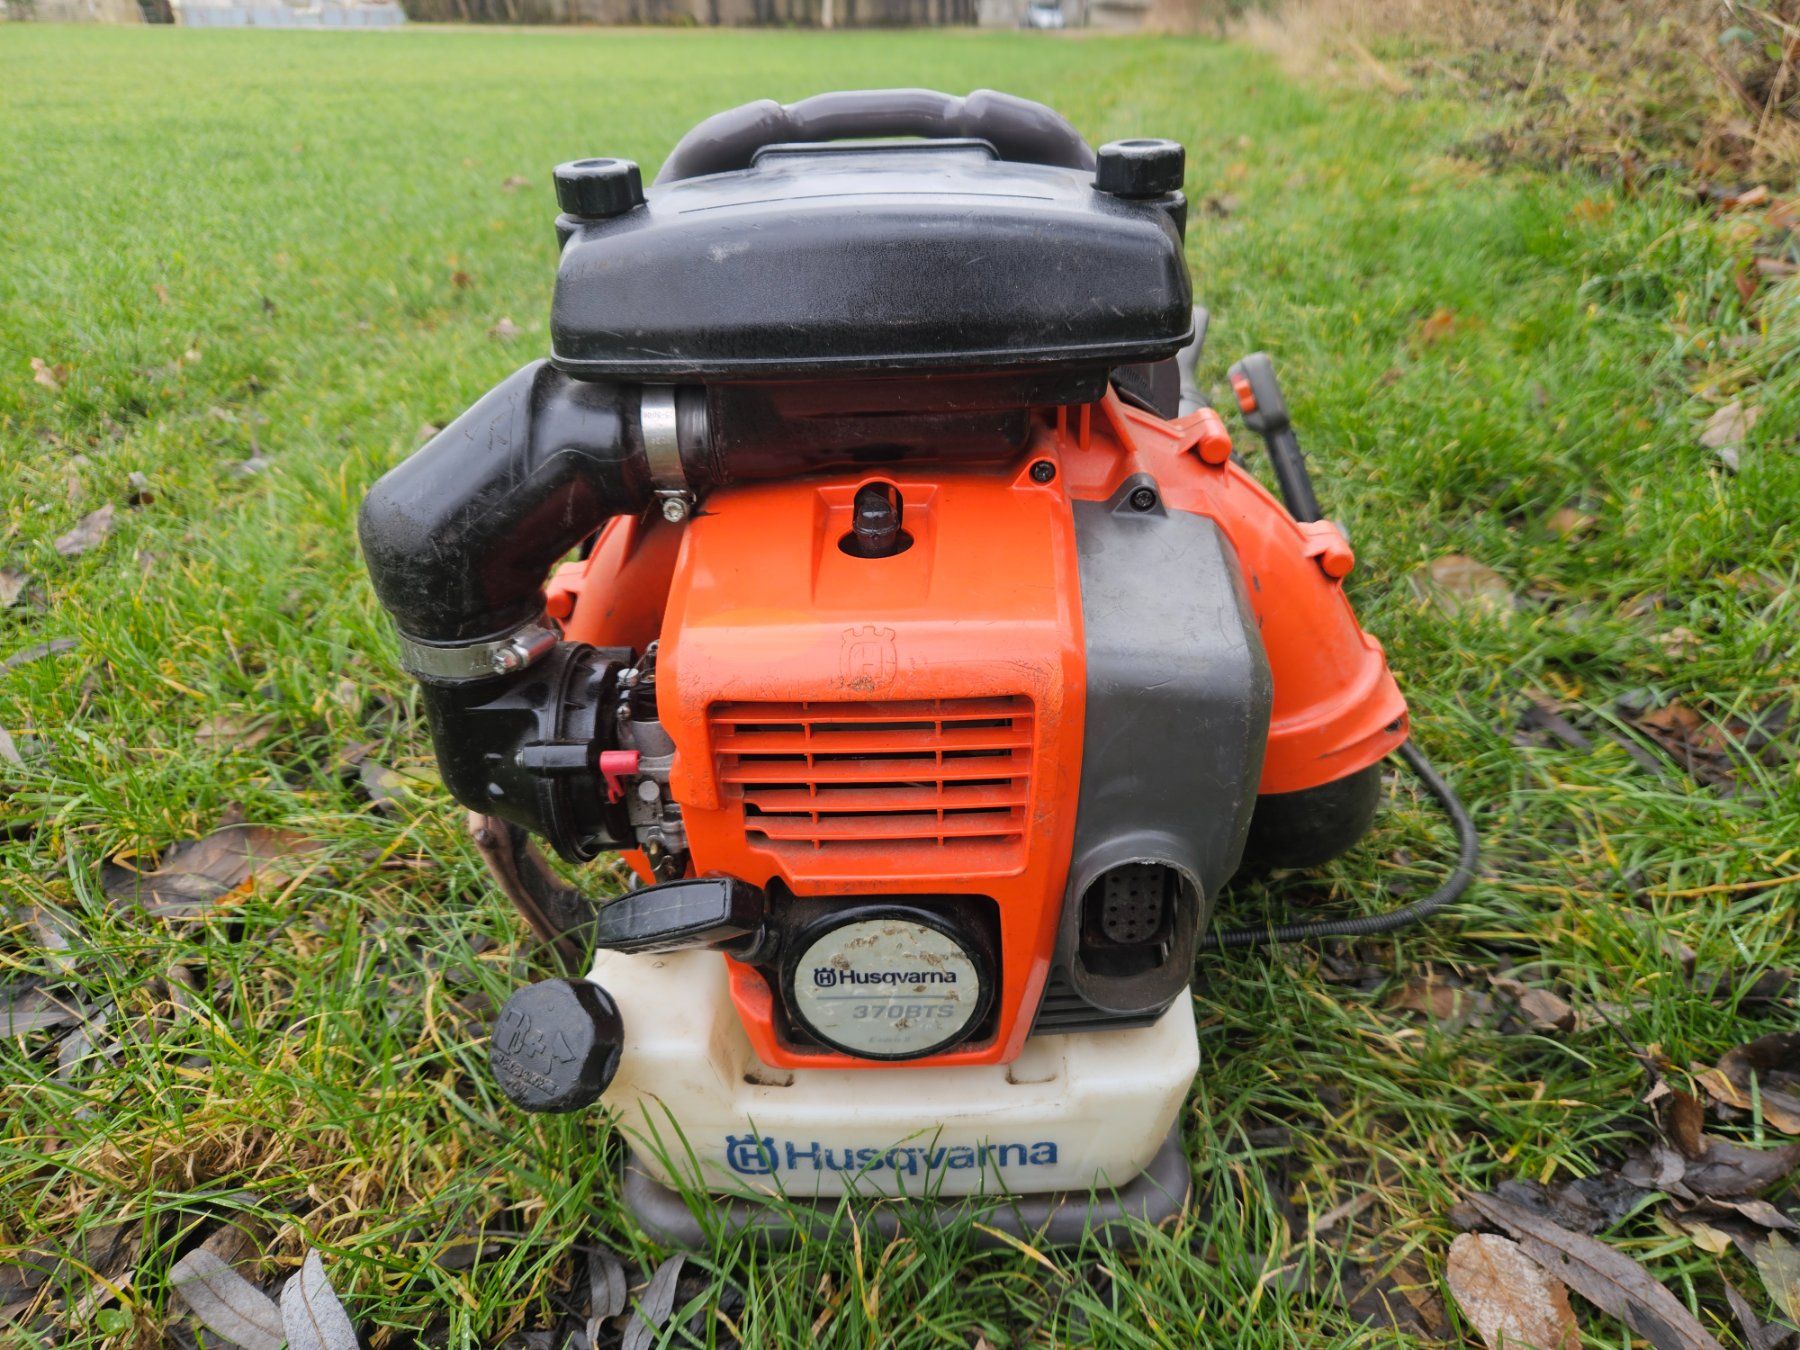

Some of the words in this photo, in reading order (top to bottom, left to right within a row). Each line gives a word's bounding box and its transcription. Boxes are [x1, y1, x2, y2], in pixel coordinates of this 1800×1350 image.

[839, 969, 957, 986] Husqvarna
[852, 1004, 954, 1019] 370BTS
[785, 1139, 1058, 1176] Husqvarna
